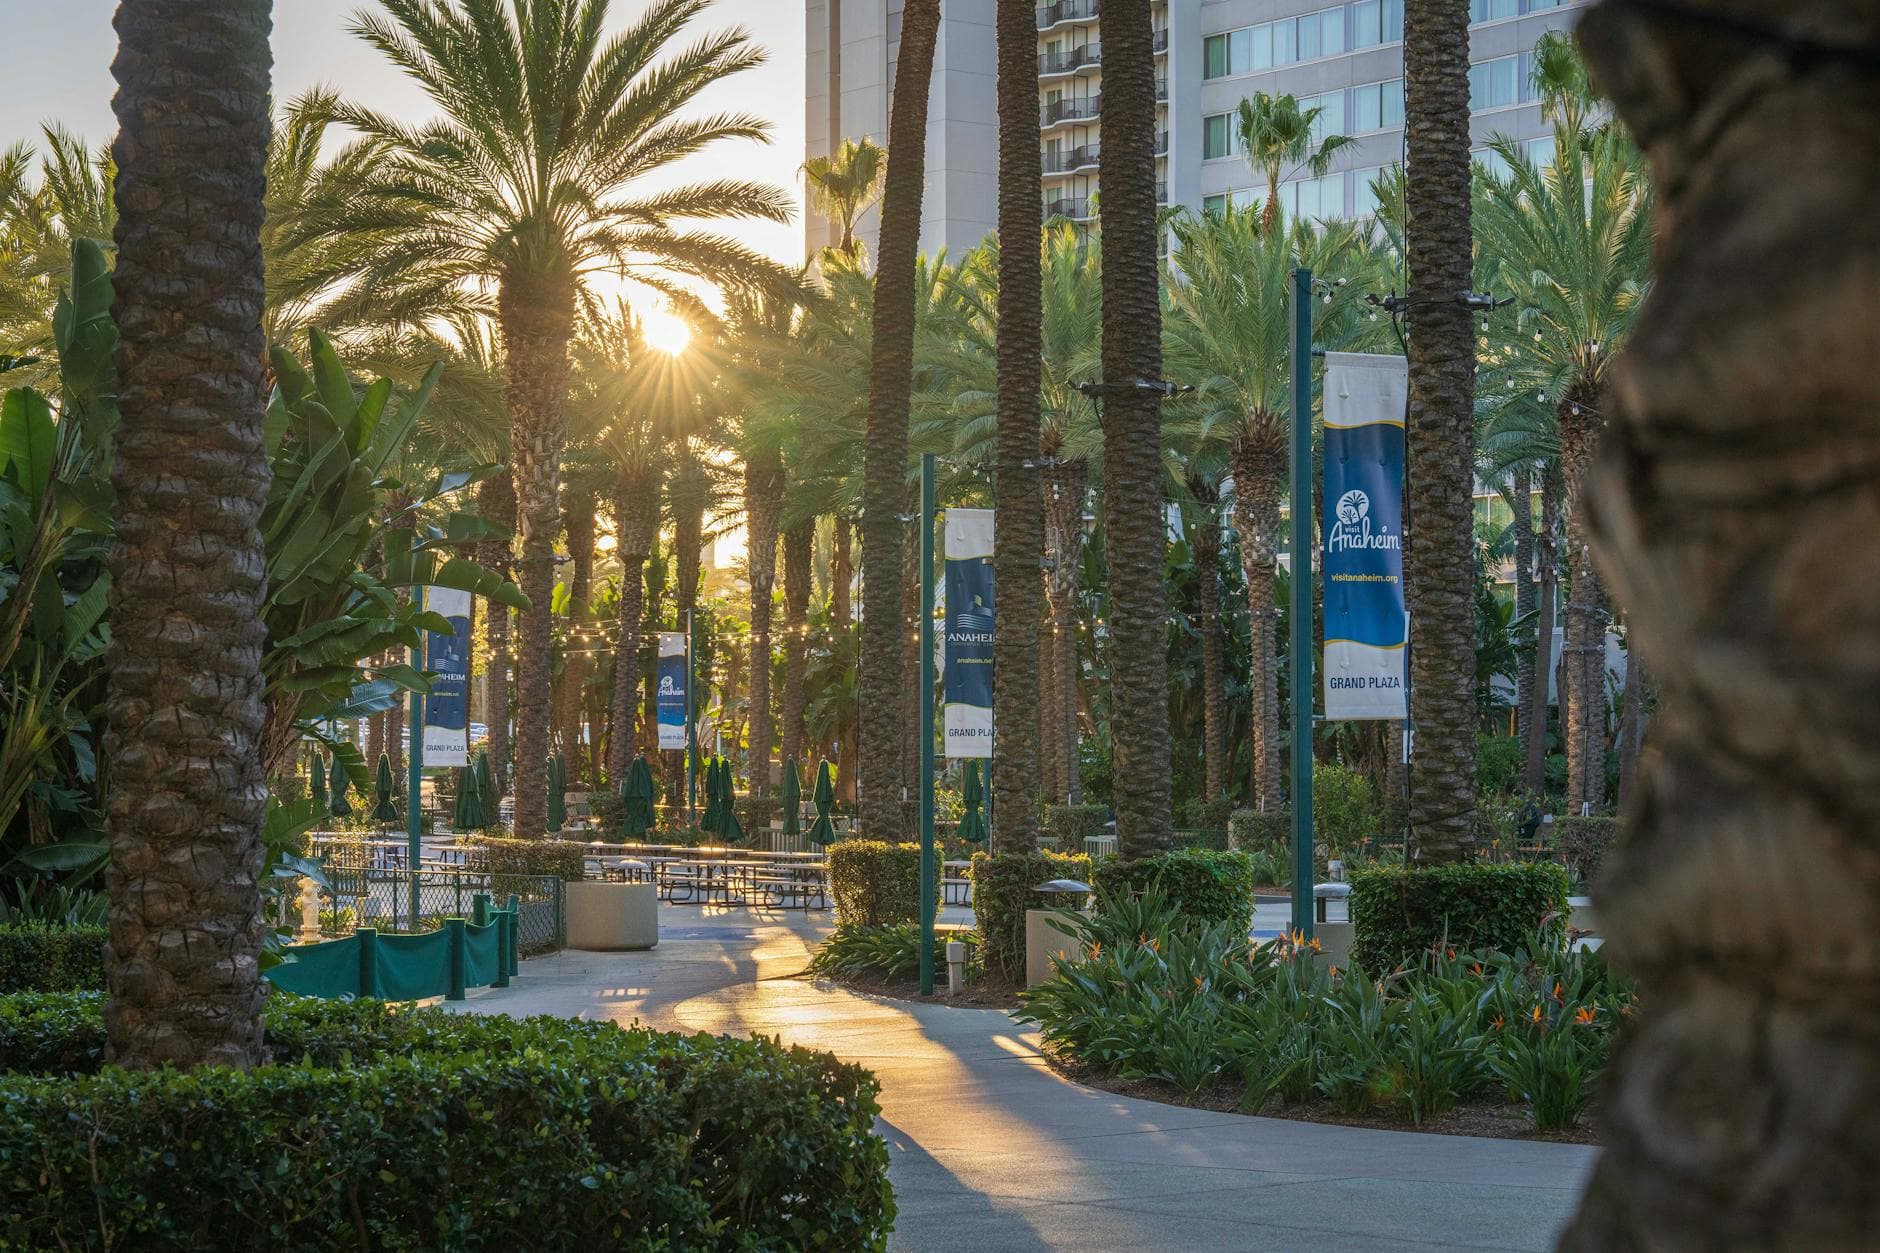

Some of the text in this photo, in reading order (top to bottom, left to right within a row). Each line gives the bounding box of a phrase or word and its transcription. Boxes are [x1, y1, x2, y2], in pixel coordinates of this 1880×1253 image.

[1345, 525, 1360, 533] visit
[1328, 516, 1400, 553] Anaheim
[1331, 572, 1399, 584] visitanaheim.org
[1330, 676, 1400, 689] GRAND PLAZA
[948, 728, 996, 737] GRAND PLA
[426, 744, 465, 752] GRAND PLAZA
